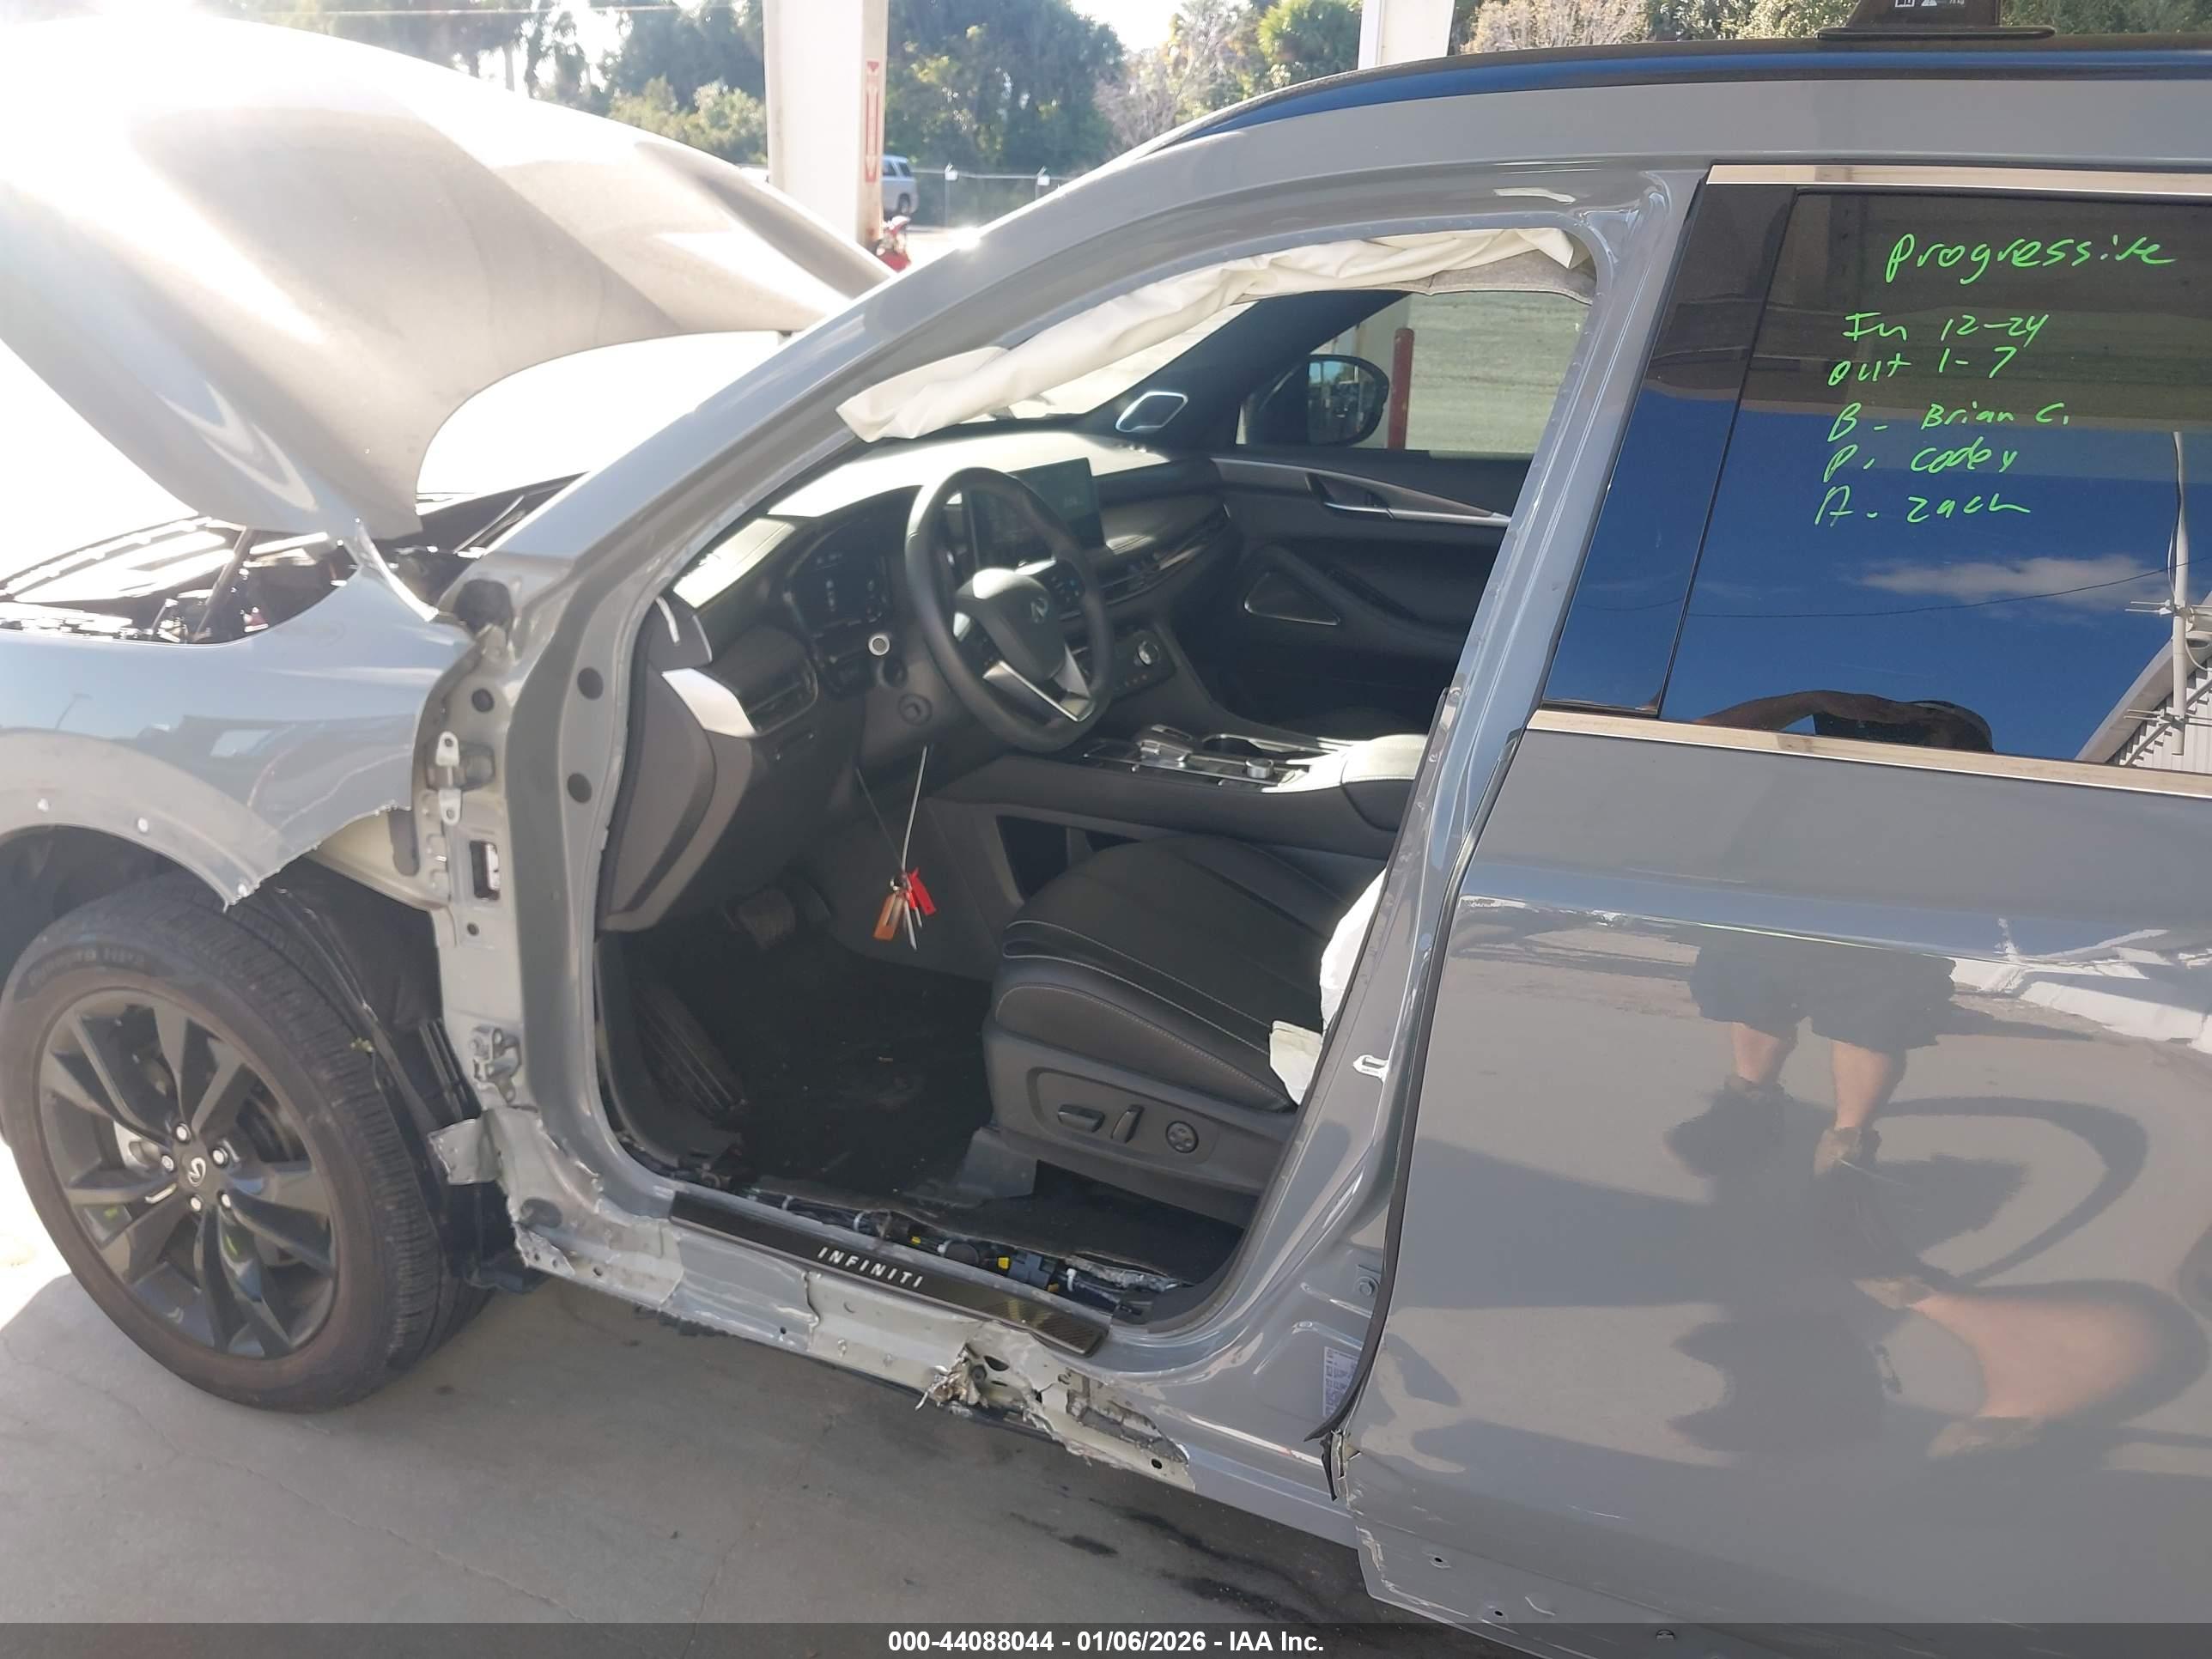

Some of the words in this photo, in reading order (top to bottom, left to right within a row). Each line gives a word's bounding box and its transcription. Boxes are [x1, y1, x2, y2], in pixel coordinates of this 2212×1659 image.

[1843, 312, 1908, 342] In
[1920, 400, 2016, 430] Brian
[817, 1247, 923, 1288] INFINITI
